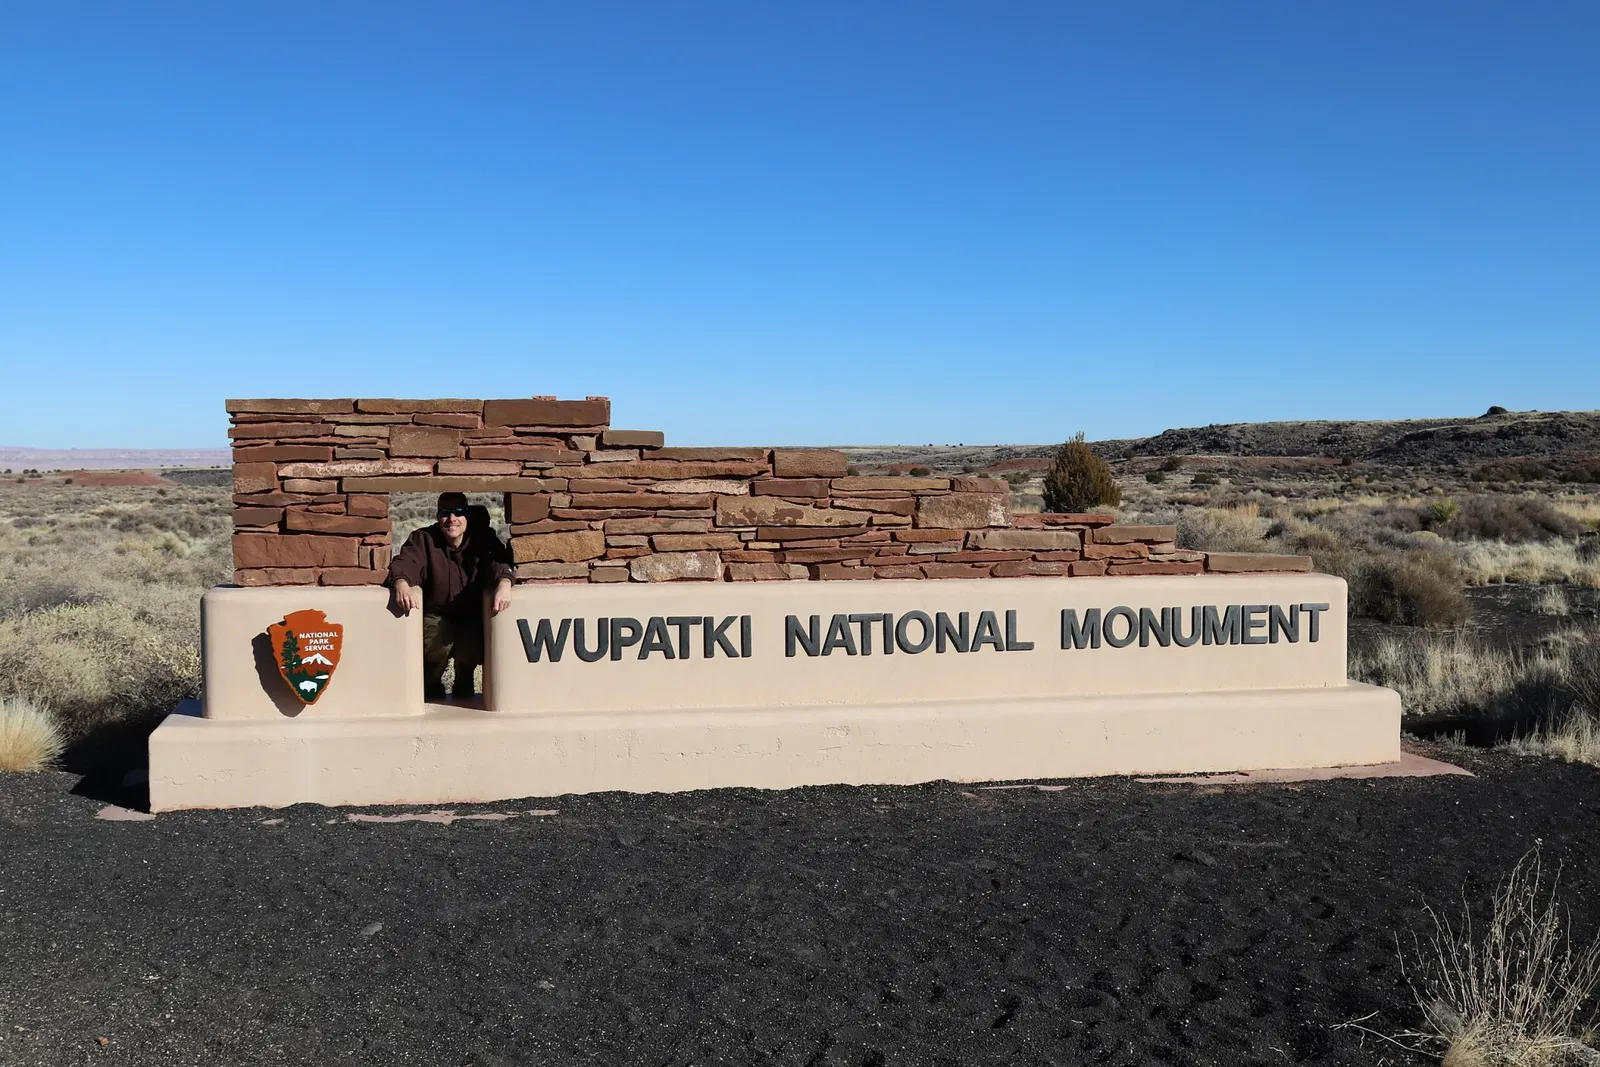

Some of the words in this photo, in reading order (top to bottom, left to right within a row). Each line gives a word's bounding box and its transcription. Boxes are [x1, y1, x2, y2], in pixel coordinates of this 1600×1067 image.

[304, 644, 335, 652] SERVICE
[516, 614, 752, 663] WUPATKI
[785, 609, 1035, 657] NATIONAL
[1061, 603, 1330, 650] MONUMENT
